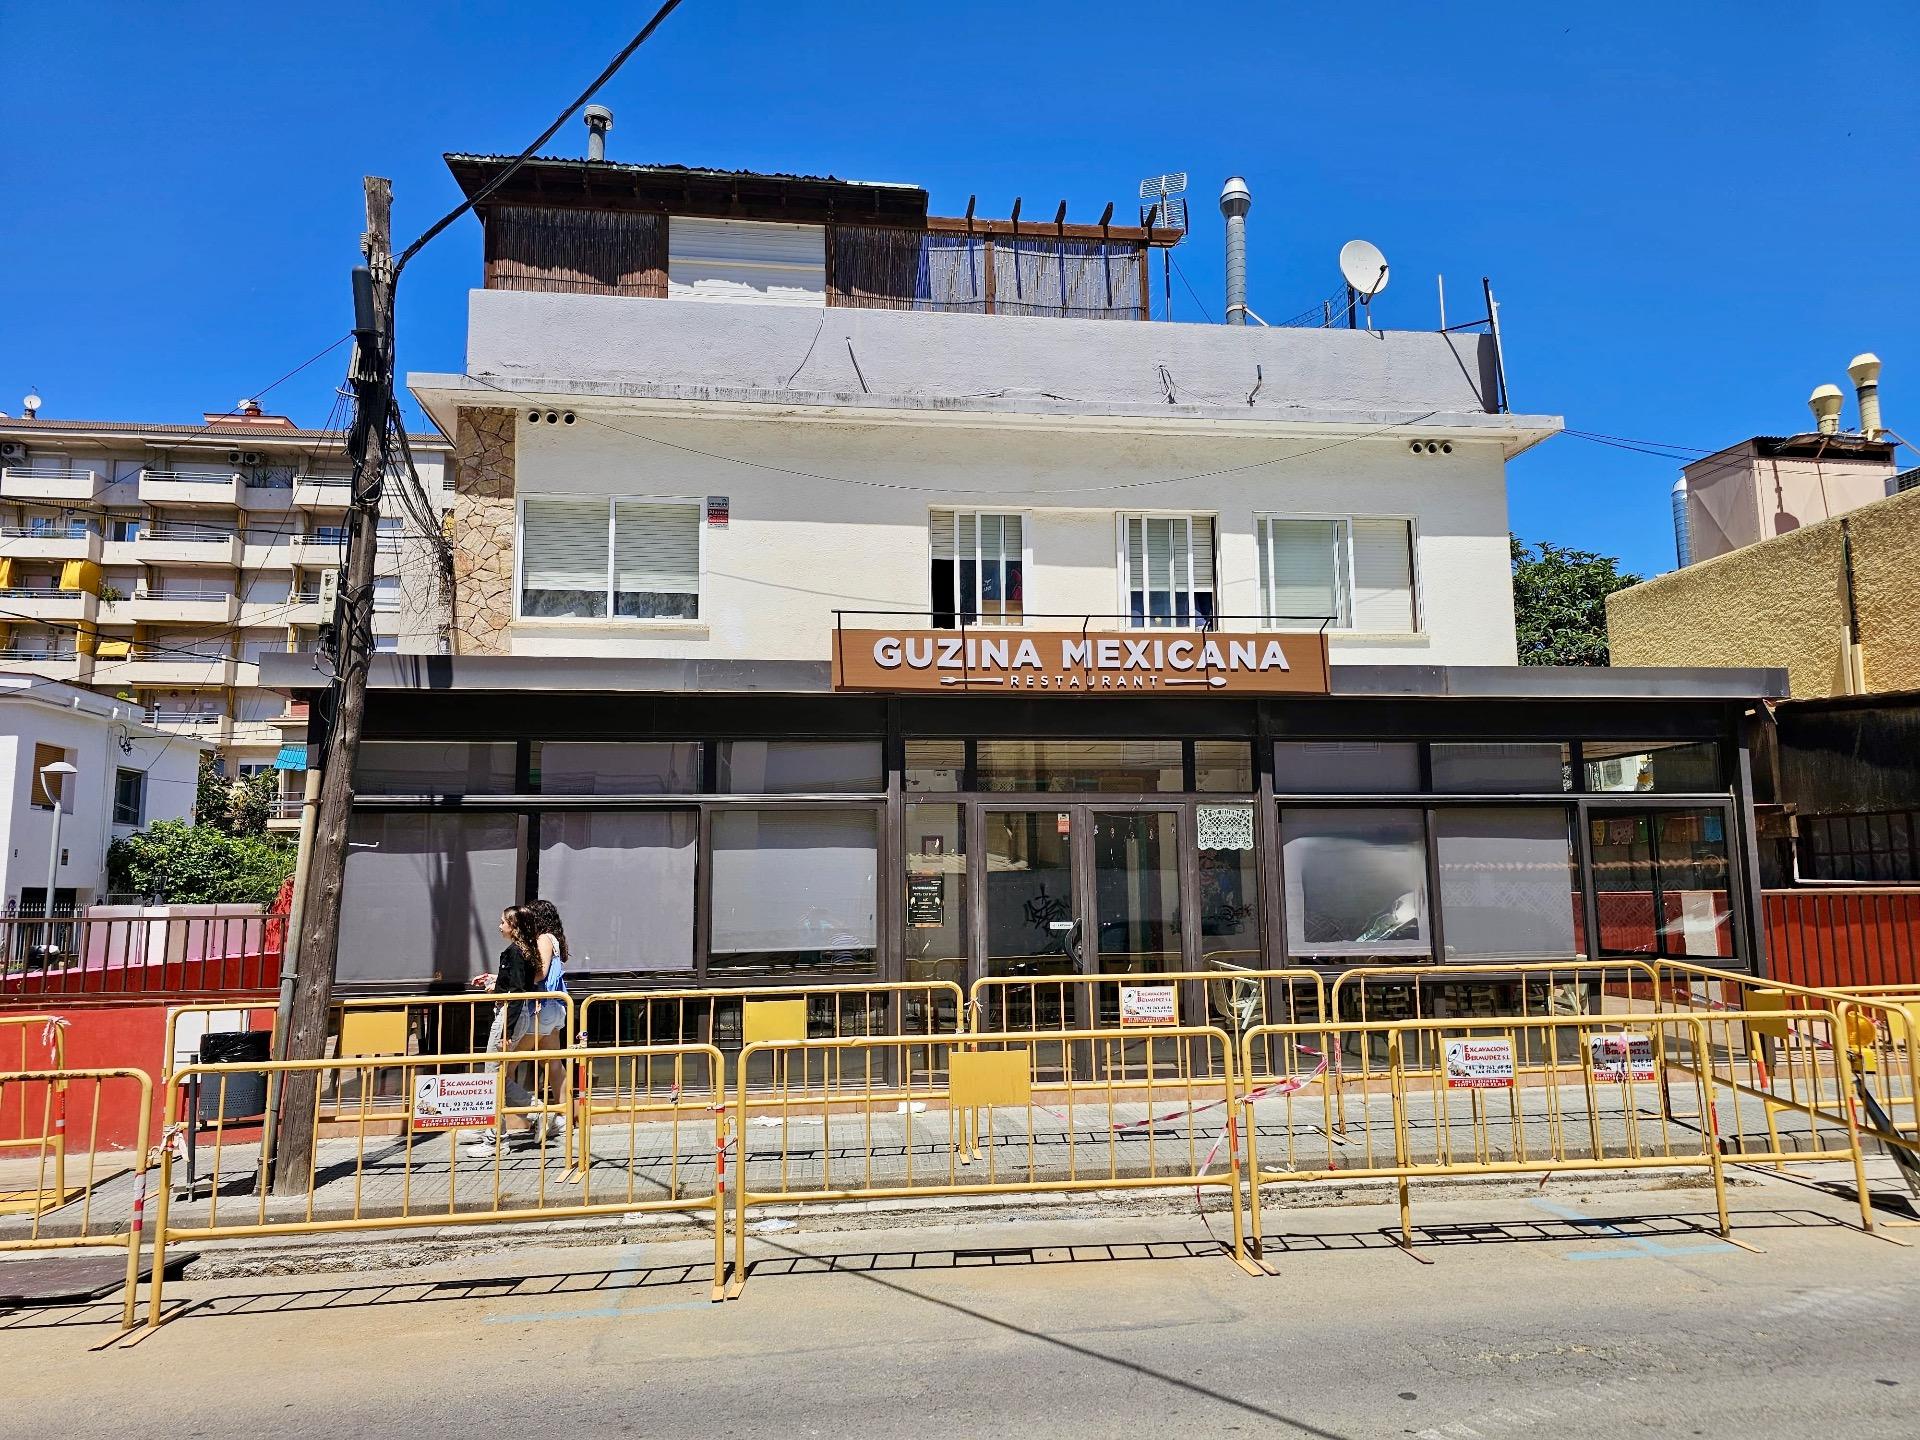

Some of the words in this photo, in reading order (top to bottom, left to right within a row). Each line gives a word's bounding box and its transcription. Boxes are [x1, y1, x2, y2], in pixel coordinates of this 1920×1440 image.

[873, 637, 1043, 669] GUZINA
[1061, 639, 1290, 671] MEXICANA
[1010, 675, 1158, 688] RESTAURANT
[1464, 1045, 1509, 1053] EXCAVACIONS
[1465, 1053, 1501, 1061] BERMUDEZ
[440, 1079, 493, 1087] EXCAVACIONS
[440, 1088, 482, 1096] BERMUDEZ
